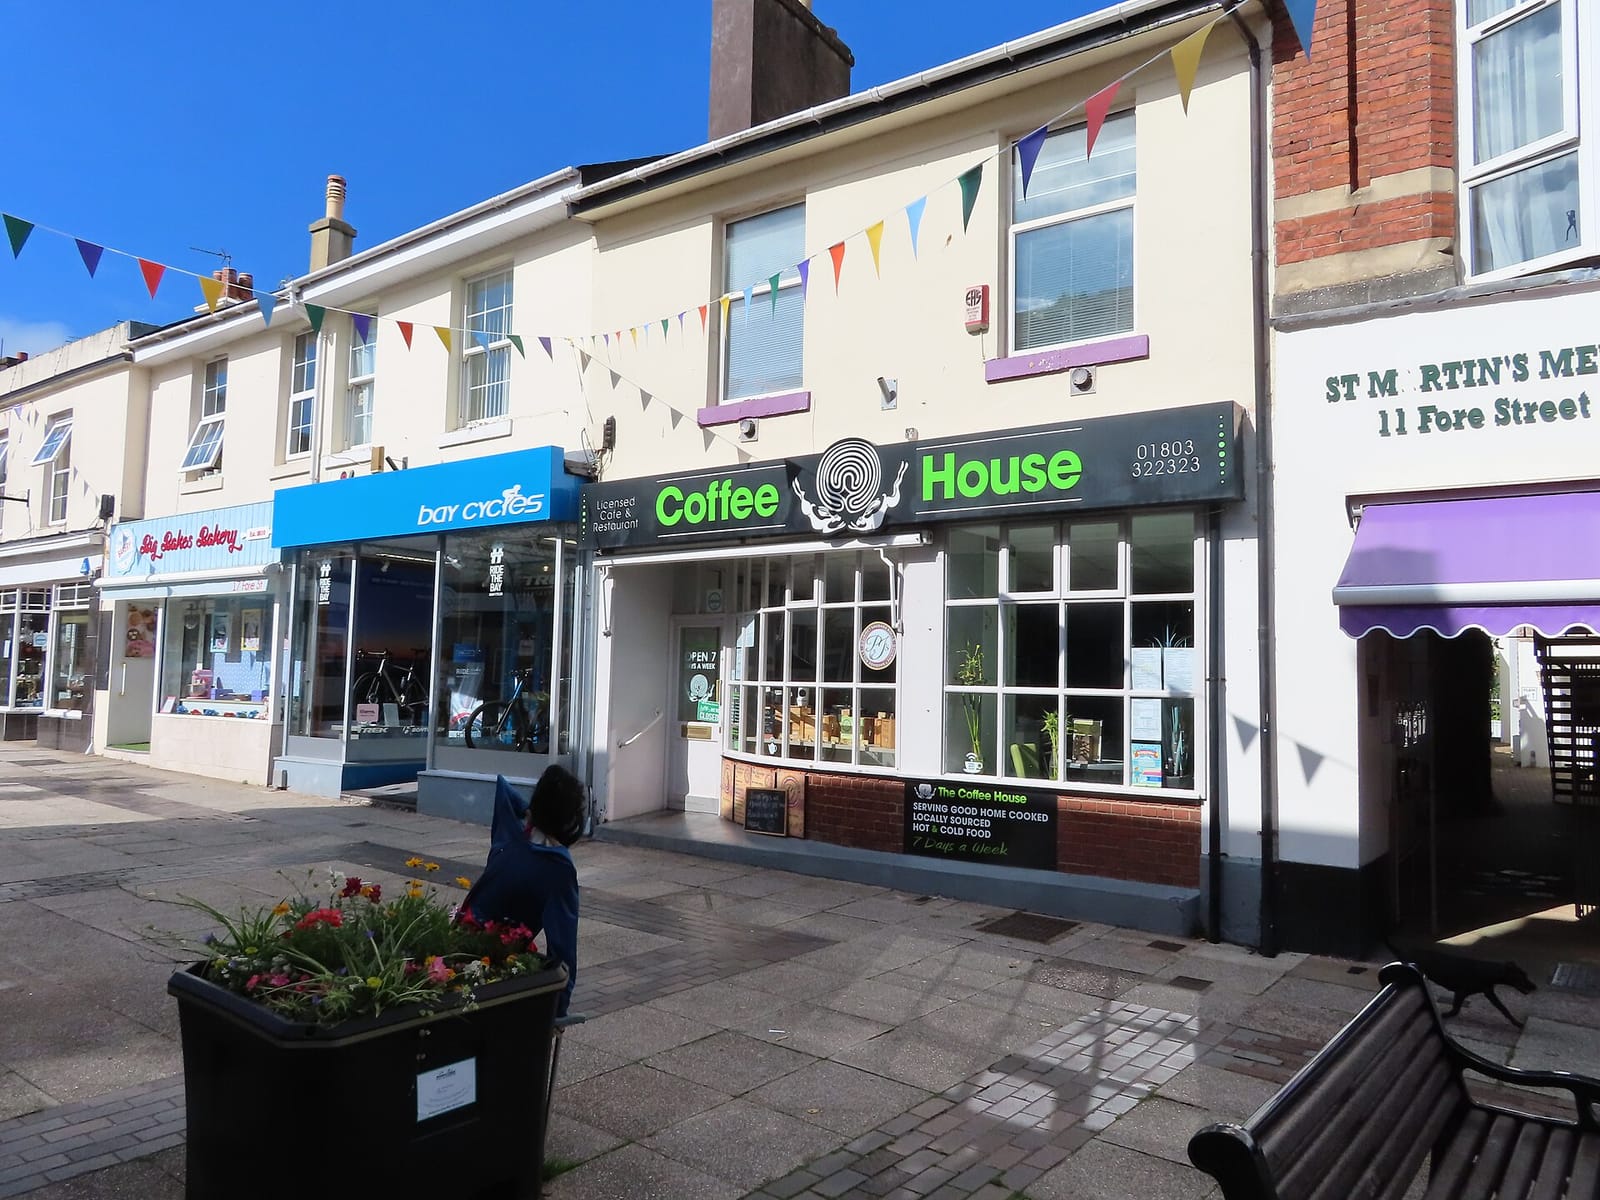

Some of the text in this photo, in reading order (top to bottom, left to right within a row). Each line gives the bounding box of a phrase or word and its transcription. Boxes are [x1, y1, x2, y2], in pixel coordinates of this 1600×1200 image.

[1326, 373, 1360, 403] ST
[1539, 344, 1600, 379] ME
[1379, 390, 1591, 437] 11 Fore Street
[1137, 439, 1195, 460] 01803
[1131, 456, 1201, 478] 322323
[655, 450, 1083, 526] Coffee House
[596, 496, 636, 510] Licensed
[600, 507, 632, 521] Cafe &
[593, 519, 638, 532] Restaurant
[139, 533, 163, 561] Big
[160, 529, 194, 552] Bakes
[195, 523, 243, 554] Bakery
[489, 565, 504, 575] RIDE
[242, 581, 256, 591] Fore
[320, 577, 331, 586] RIDE
[491, 574, 503, 583] THE
[490, 582, 502, 592] BAY
[320, 592, 329, 601] BAY
[711, 651, 717, 662] 7
[938, 786, 1028, 804] The Coffee House
[913, 802, 1049, 822] SERVING GOOD HOME COOKED
[913, 812, 991, 828] LOCALLY SOURCED
[912, 823, 991, 838] HOT & COLD FOOD
[912, 836, 922, 847] 7
[924, 838, 954, 853] Days
[972, 842, 1008, 855] Week
